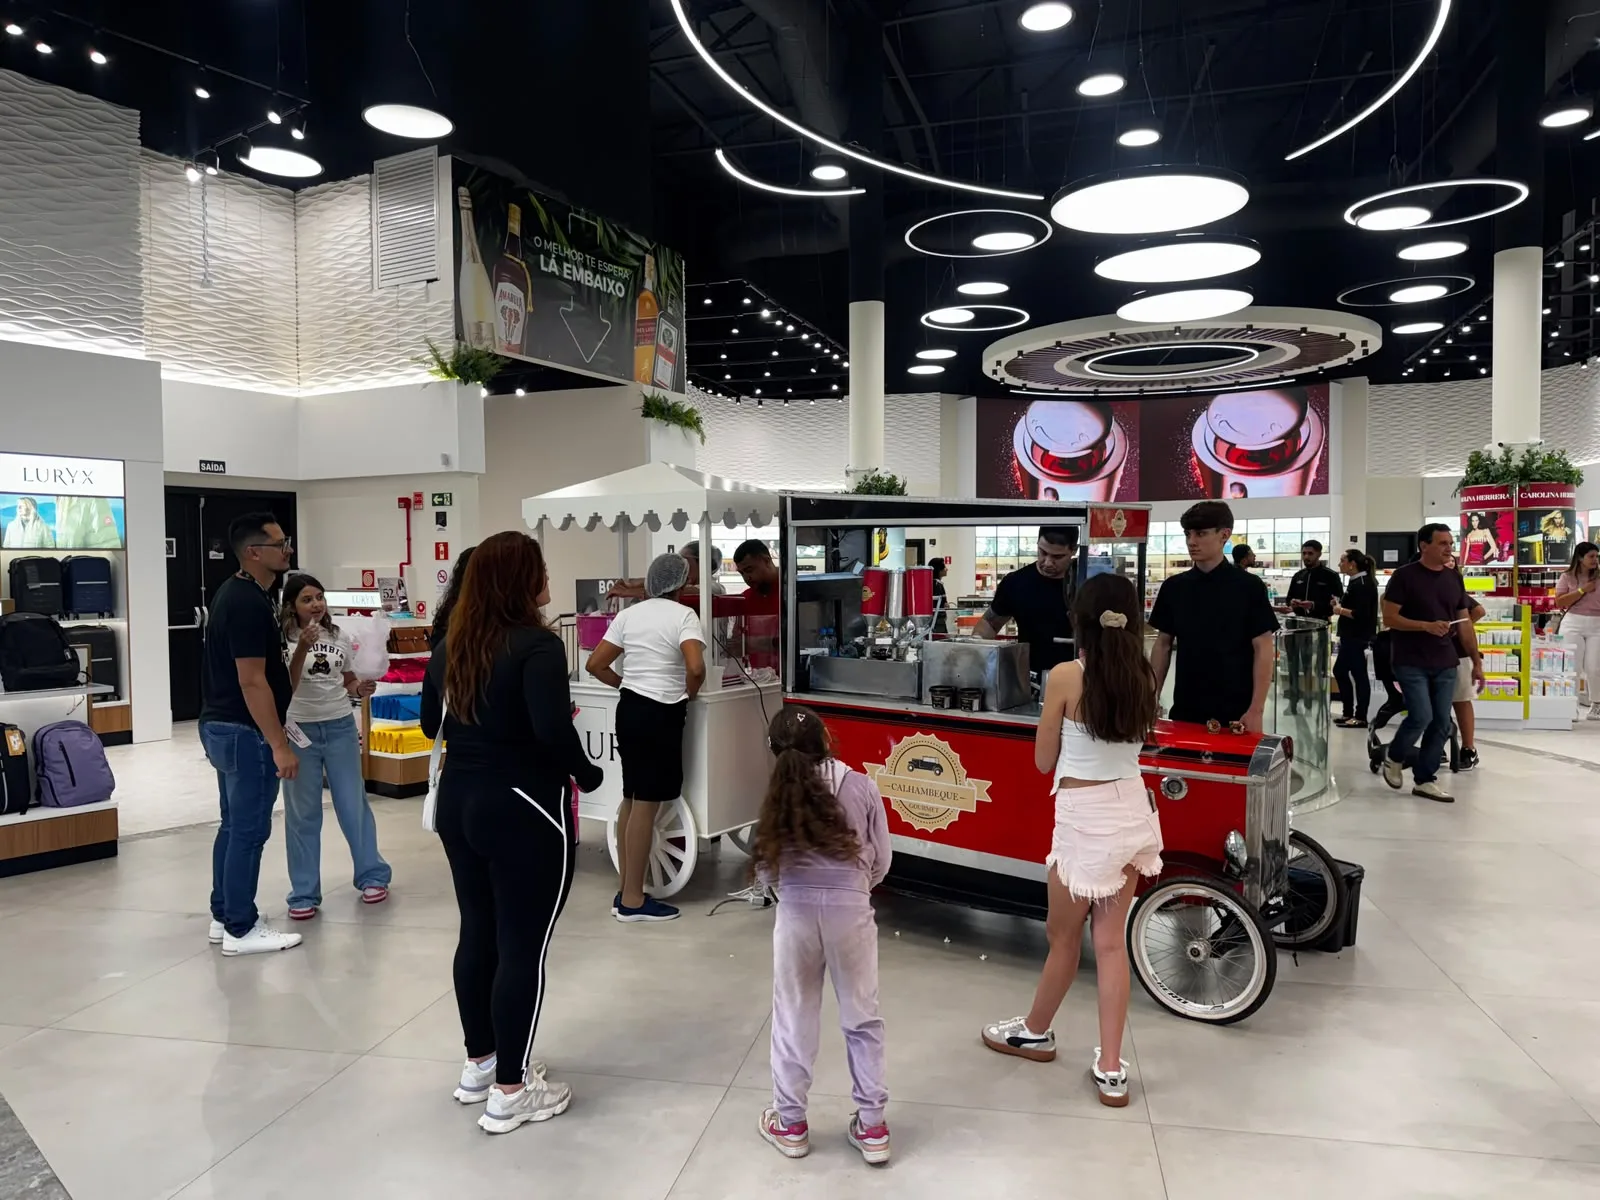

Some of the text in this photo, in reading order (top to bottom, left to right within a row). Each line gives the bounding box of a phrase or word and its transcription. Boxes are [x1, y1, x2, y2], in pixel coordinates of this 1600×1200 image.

[533, 236, 630, 281] O MELHOR TE ESPERA
[540, 253, 626, 298] LÁ EMBAIXO
[23, 467, 94, 486] LURYX
[200, 462, 225, 473] SAÍDA
[1477, 493, 1511, 502] HERRERA
[891, 782, 959, 801] CALHAMBEQUE
[908, 803, 940, 813] GOURMET
